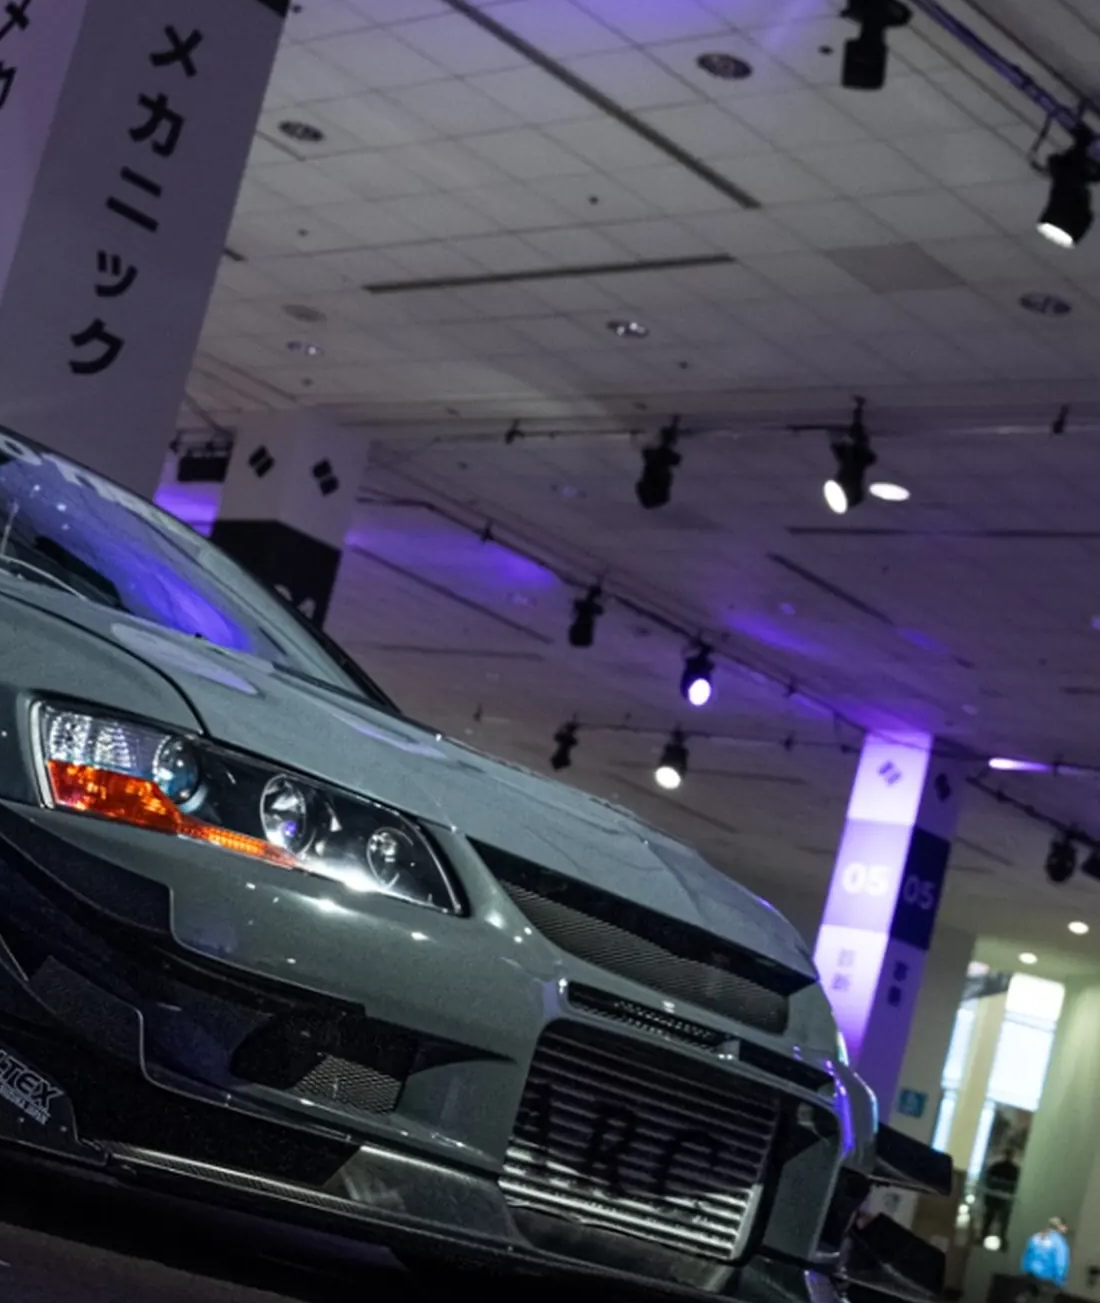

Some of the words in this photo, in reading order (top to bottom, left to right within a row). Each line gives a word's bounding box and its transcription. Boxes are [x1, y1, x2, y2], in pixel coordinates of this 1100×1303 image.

[68, 25, 203, 375] メカニック
[843, 862, 891, 896] 05
[903, 875, 936, 910] 05
